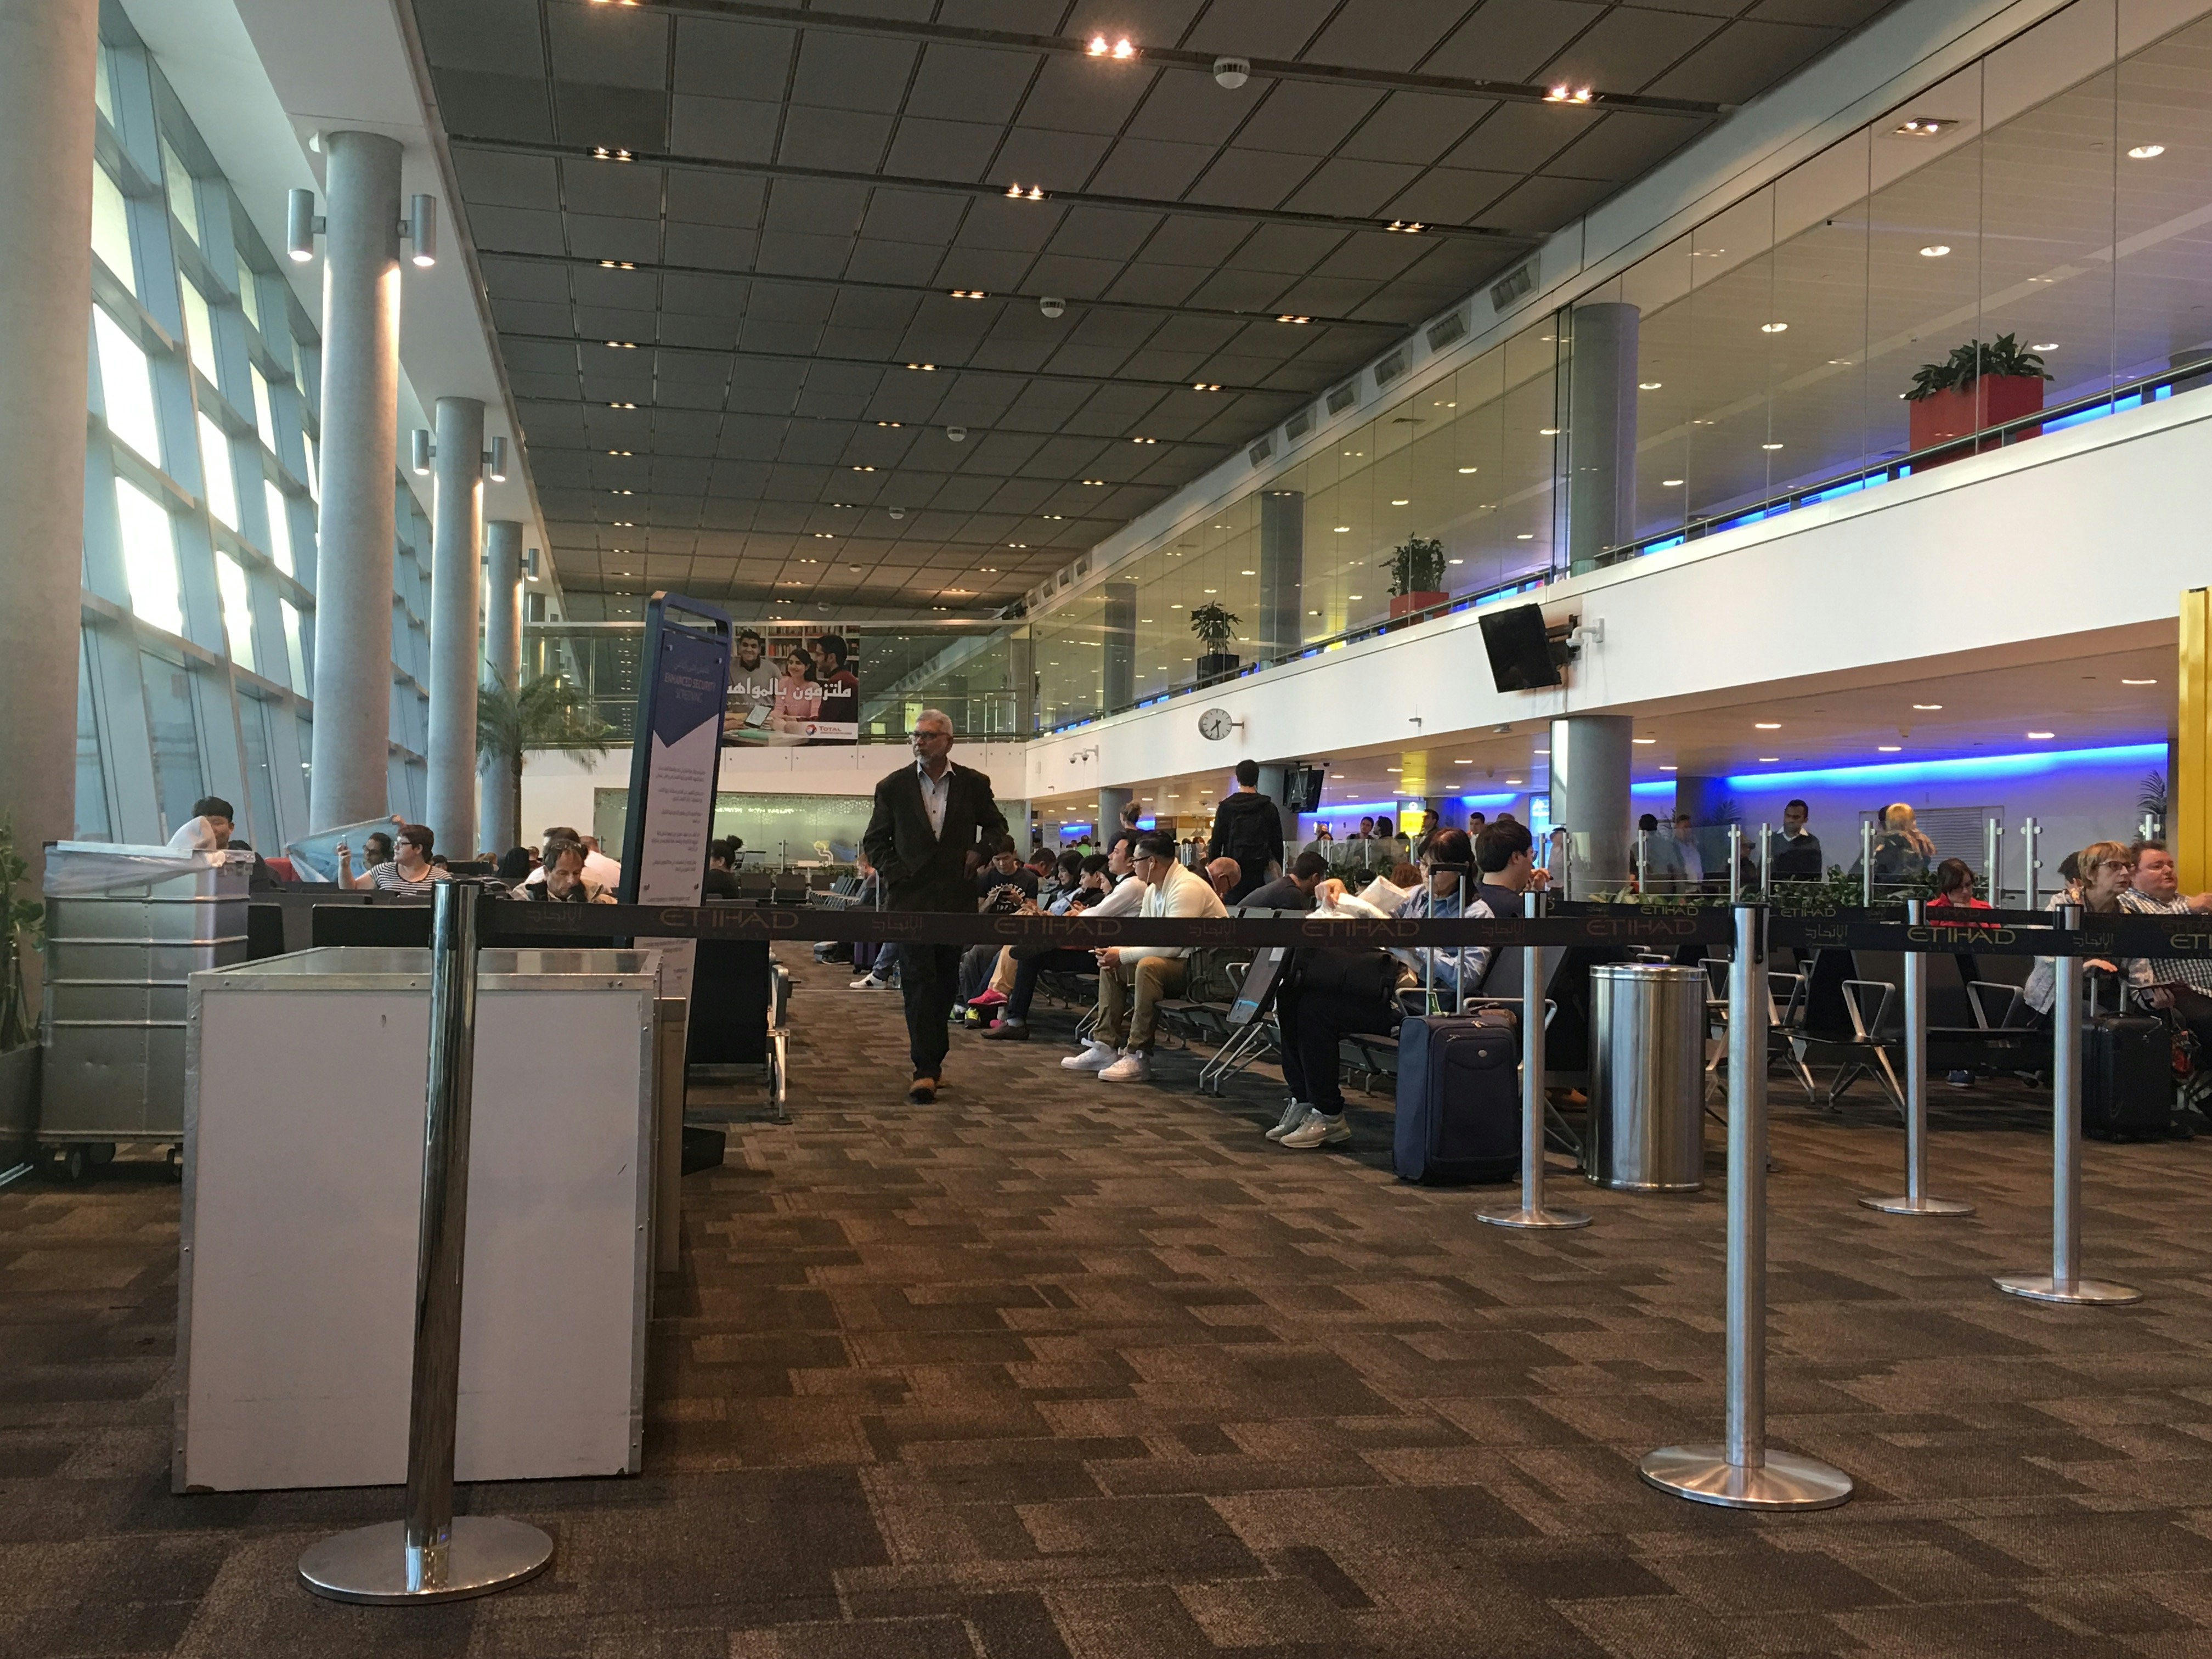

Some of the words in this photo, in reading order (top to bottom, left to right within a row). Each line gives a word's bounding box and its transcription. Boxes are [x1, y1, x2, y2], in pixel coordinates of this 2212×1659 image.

[792, 680, 851, 701] ملتزمون
[659, 909, 799, 929] ETIHAD
[1640, 905, 1699, 917] ETIHAD
[1780, 907, 1837, 917] ETIHAD
[994, 917, 1122, 935] ETIHAD
[1301, 920, 1420, 937] ETIHAD
[1585, 919, 1697, 936] ETIHAD
[1907, 926, 2017, 945] ETIHAD
